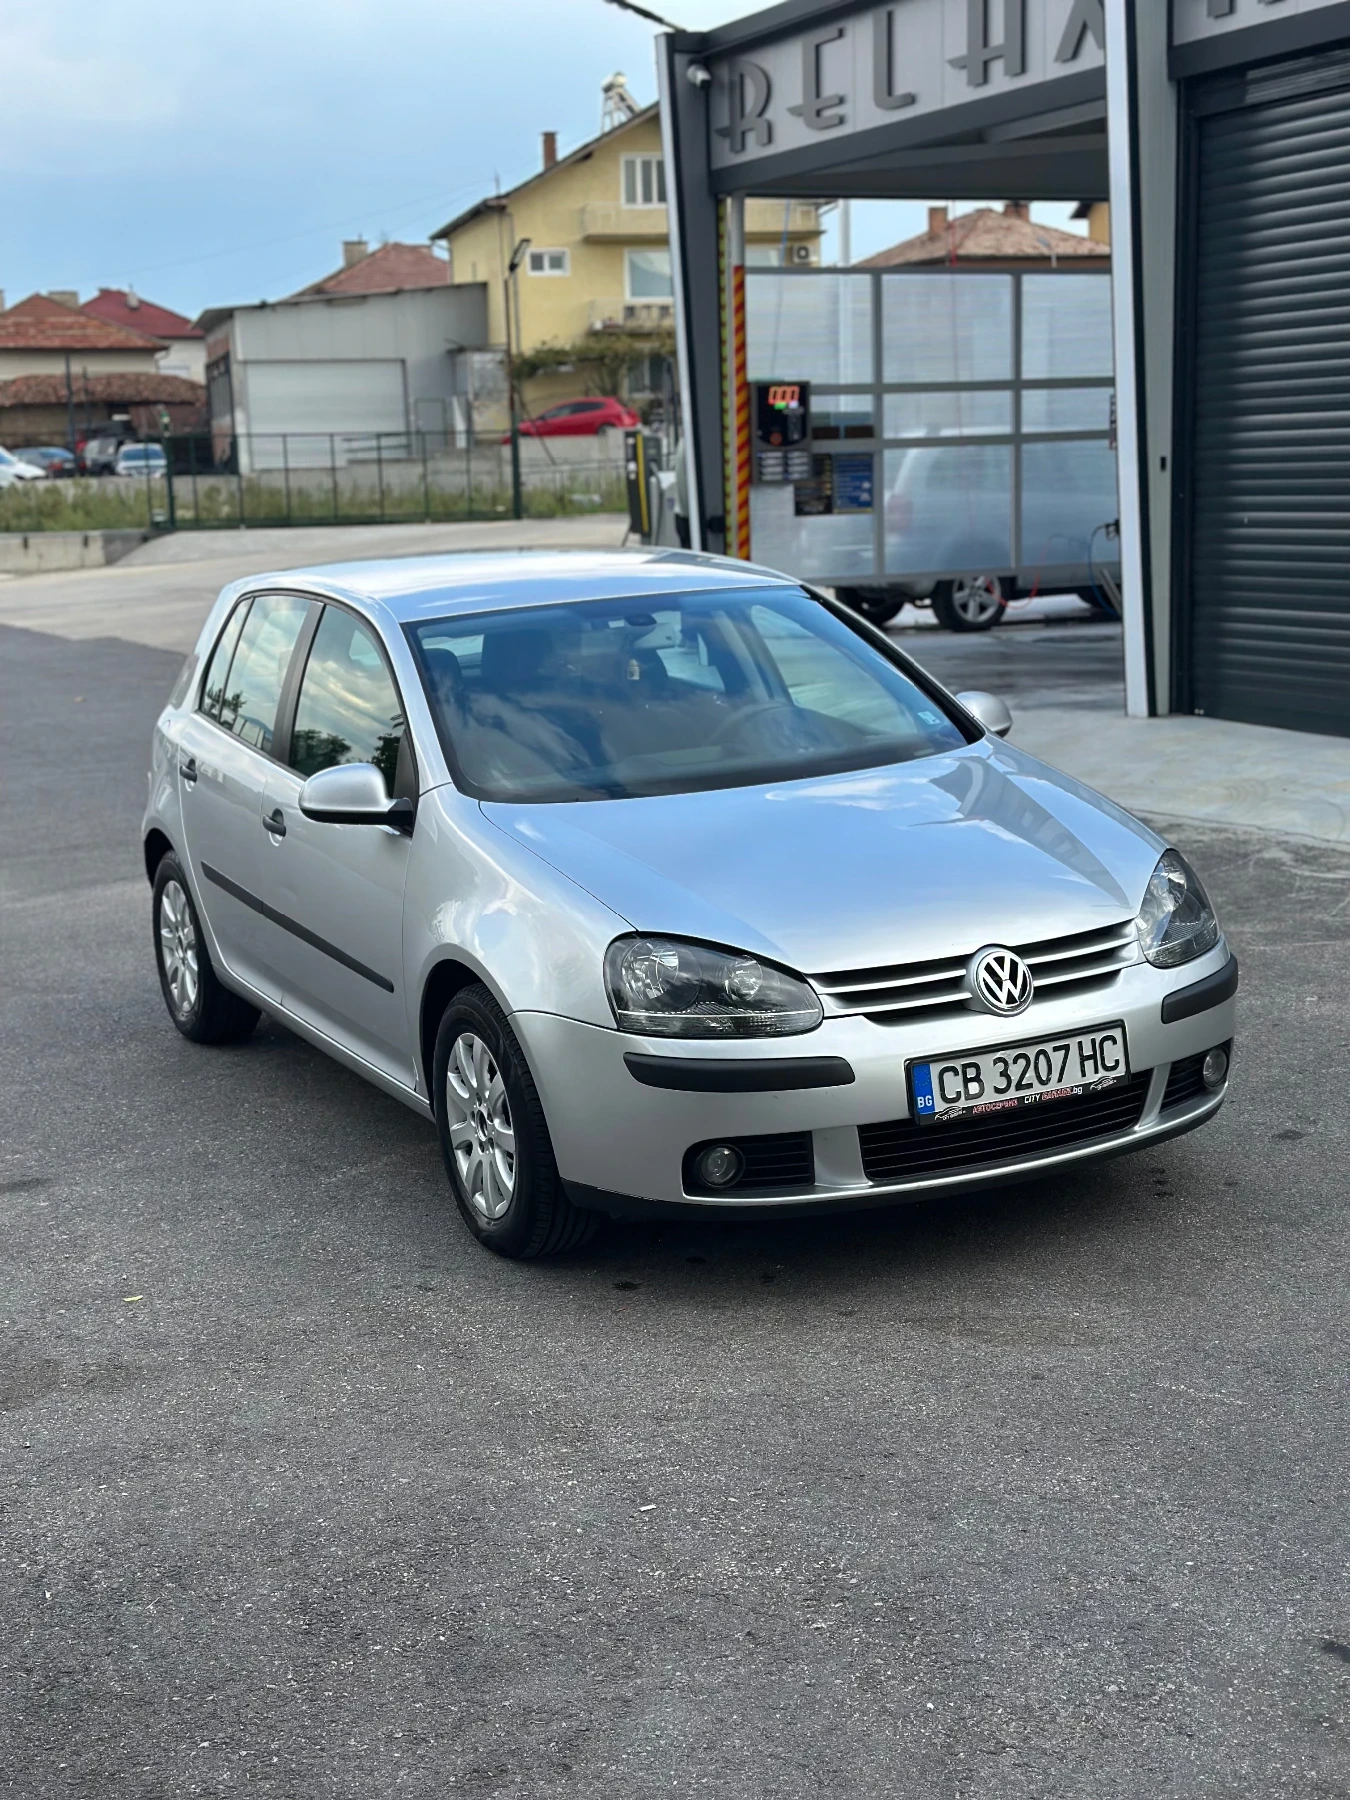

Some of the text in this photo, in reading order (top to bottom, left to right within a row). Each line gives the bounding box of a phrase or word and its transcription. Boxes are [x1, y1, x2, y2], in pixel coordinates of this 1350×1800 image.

[977, 951, 1030, 1009] VW
[938, 1034, 1121, 1104] CB 3207 HC
[916, 1095, 933, 1108] BG
[1024, 1093, 1041, 1104] CITY
